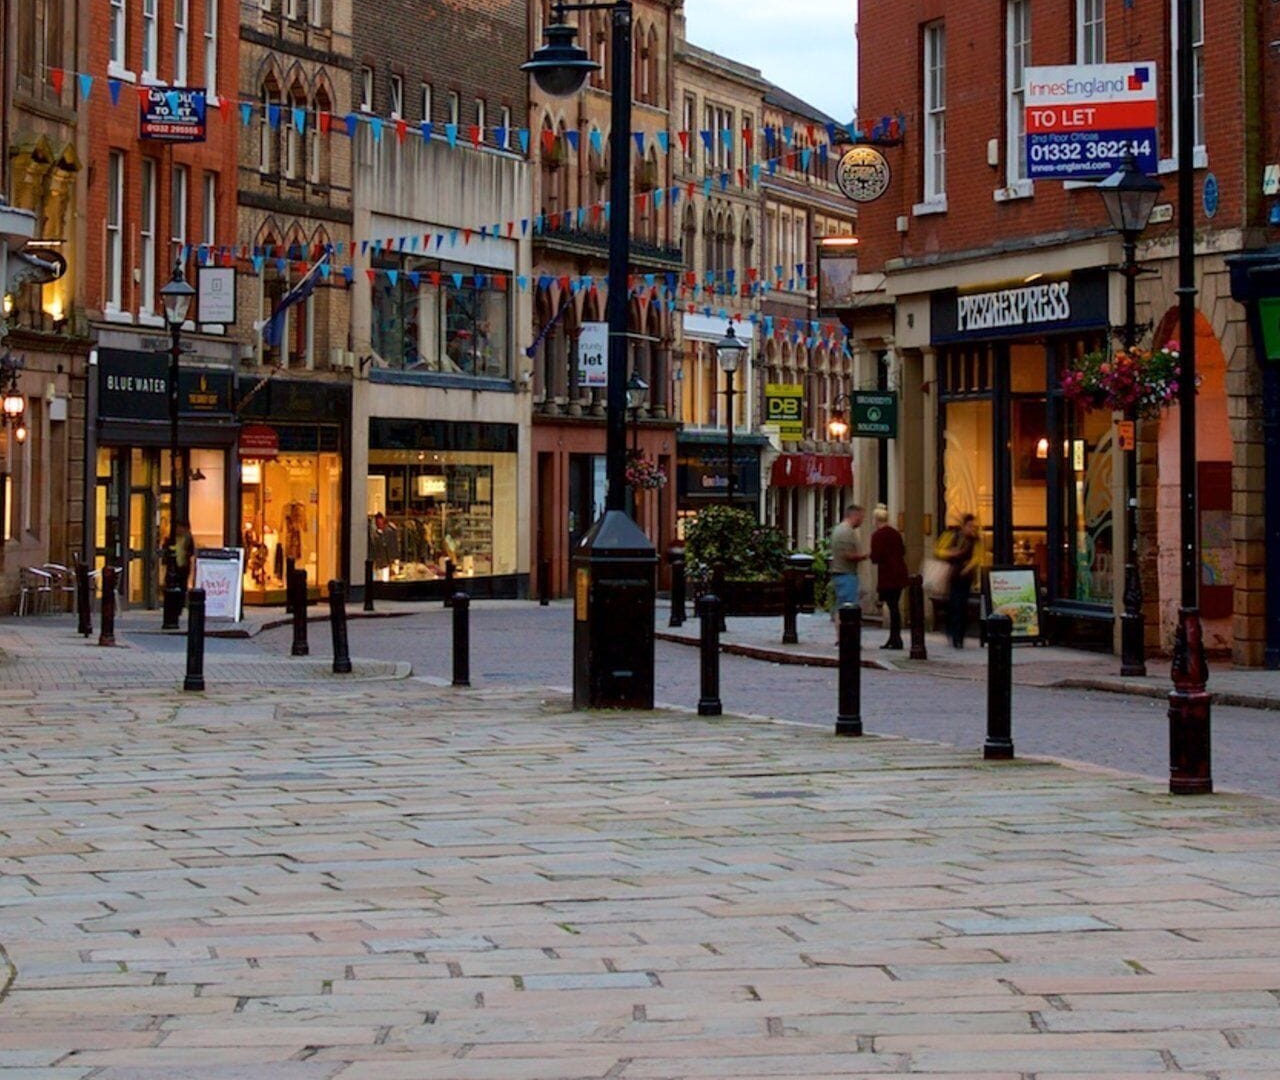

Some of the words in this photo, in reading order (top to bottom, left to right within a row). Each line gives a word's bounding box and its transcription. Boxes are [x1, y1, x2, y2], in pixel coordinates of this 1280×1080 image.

[1029, 76, 1124, 98] InnesEngland
[155, 106, 169, 115] TO
[1031, 110, 1056, 127] TO
[1062, 108, 1096, 126] LET
[1031, 143, 1081, 161] 01332
[1031, 161, 1112, 173] innes-england.com
[583, 353, 603, 366] let
[107, 375, 134, 391] BLUE
[135, 377, 166, 394] WATER
[768, 398, 799, 414] DB
